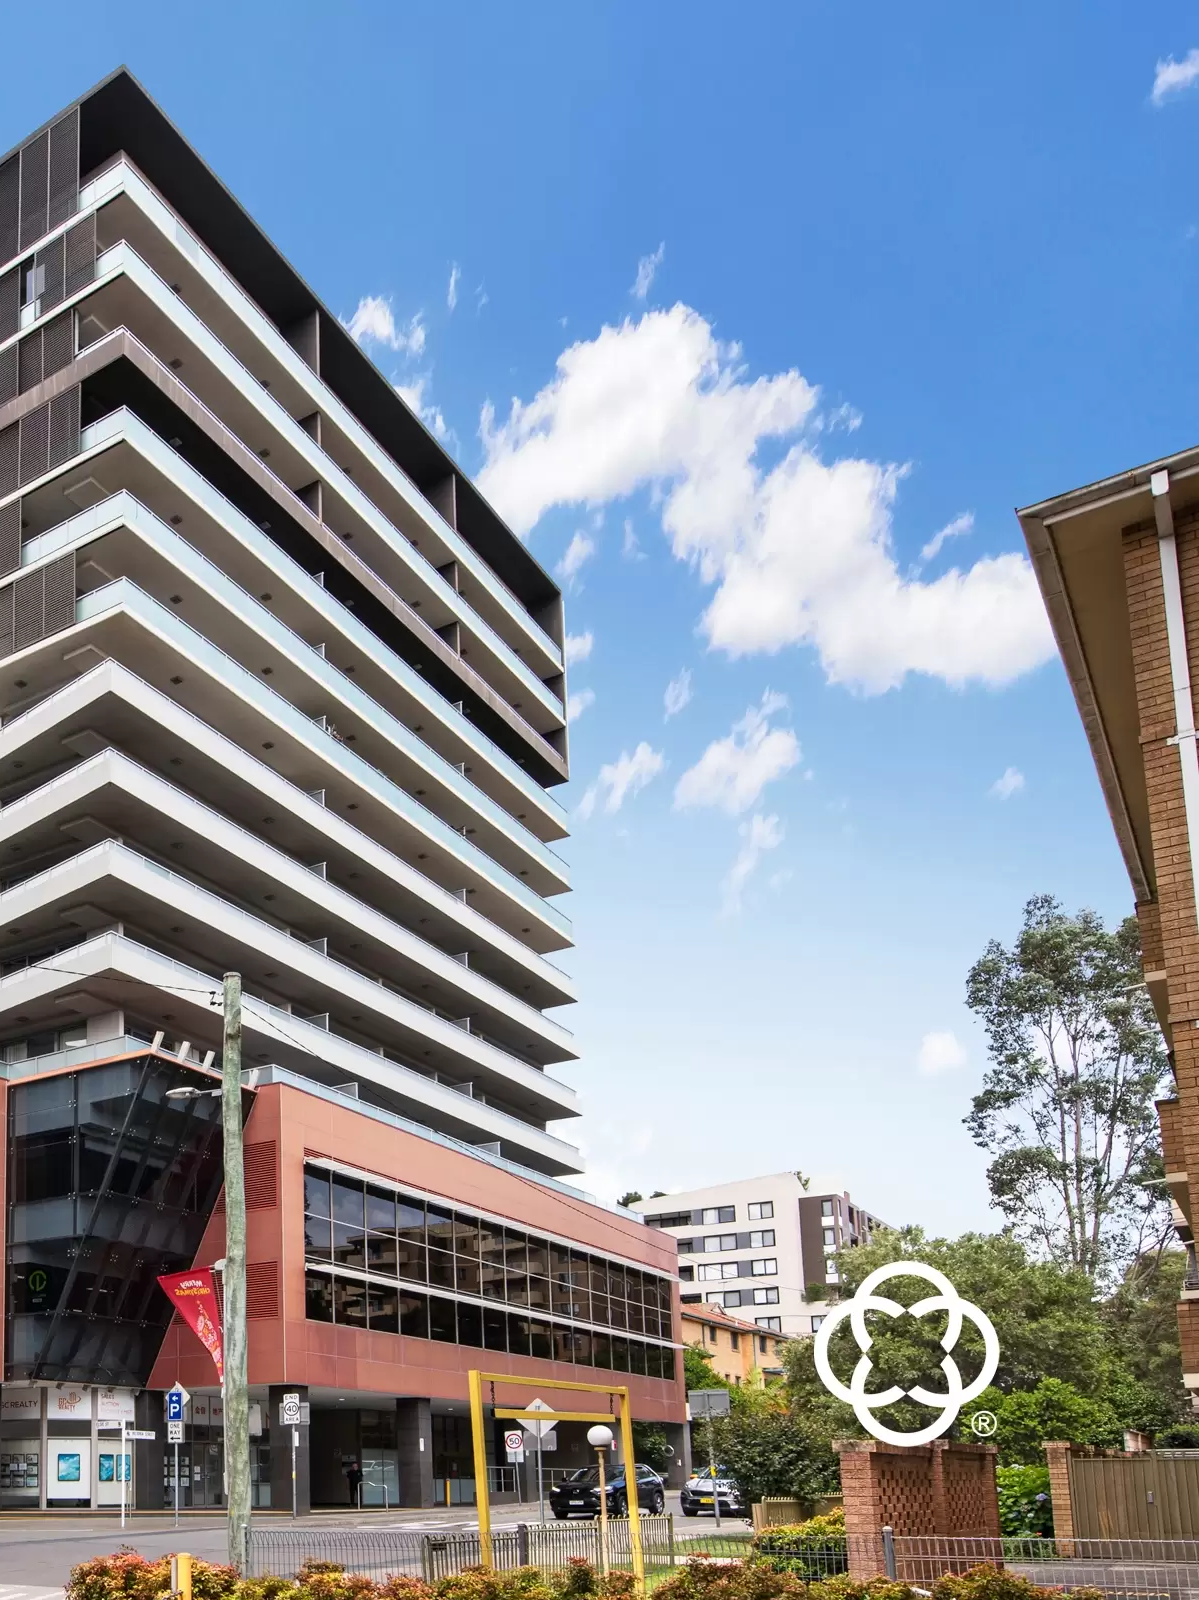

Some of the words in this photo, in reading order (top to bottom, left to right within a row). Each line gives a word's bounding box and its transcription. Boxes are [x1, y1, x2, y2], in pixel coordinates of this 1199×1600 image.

[10, 1400, 38, 1408] REALTY
[170, 1403, 180, 1417] P
[509, 1437, 520, 1446] 50
